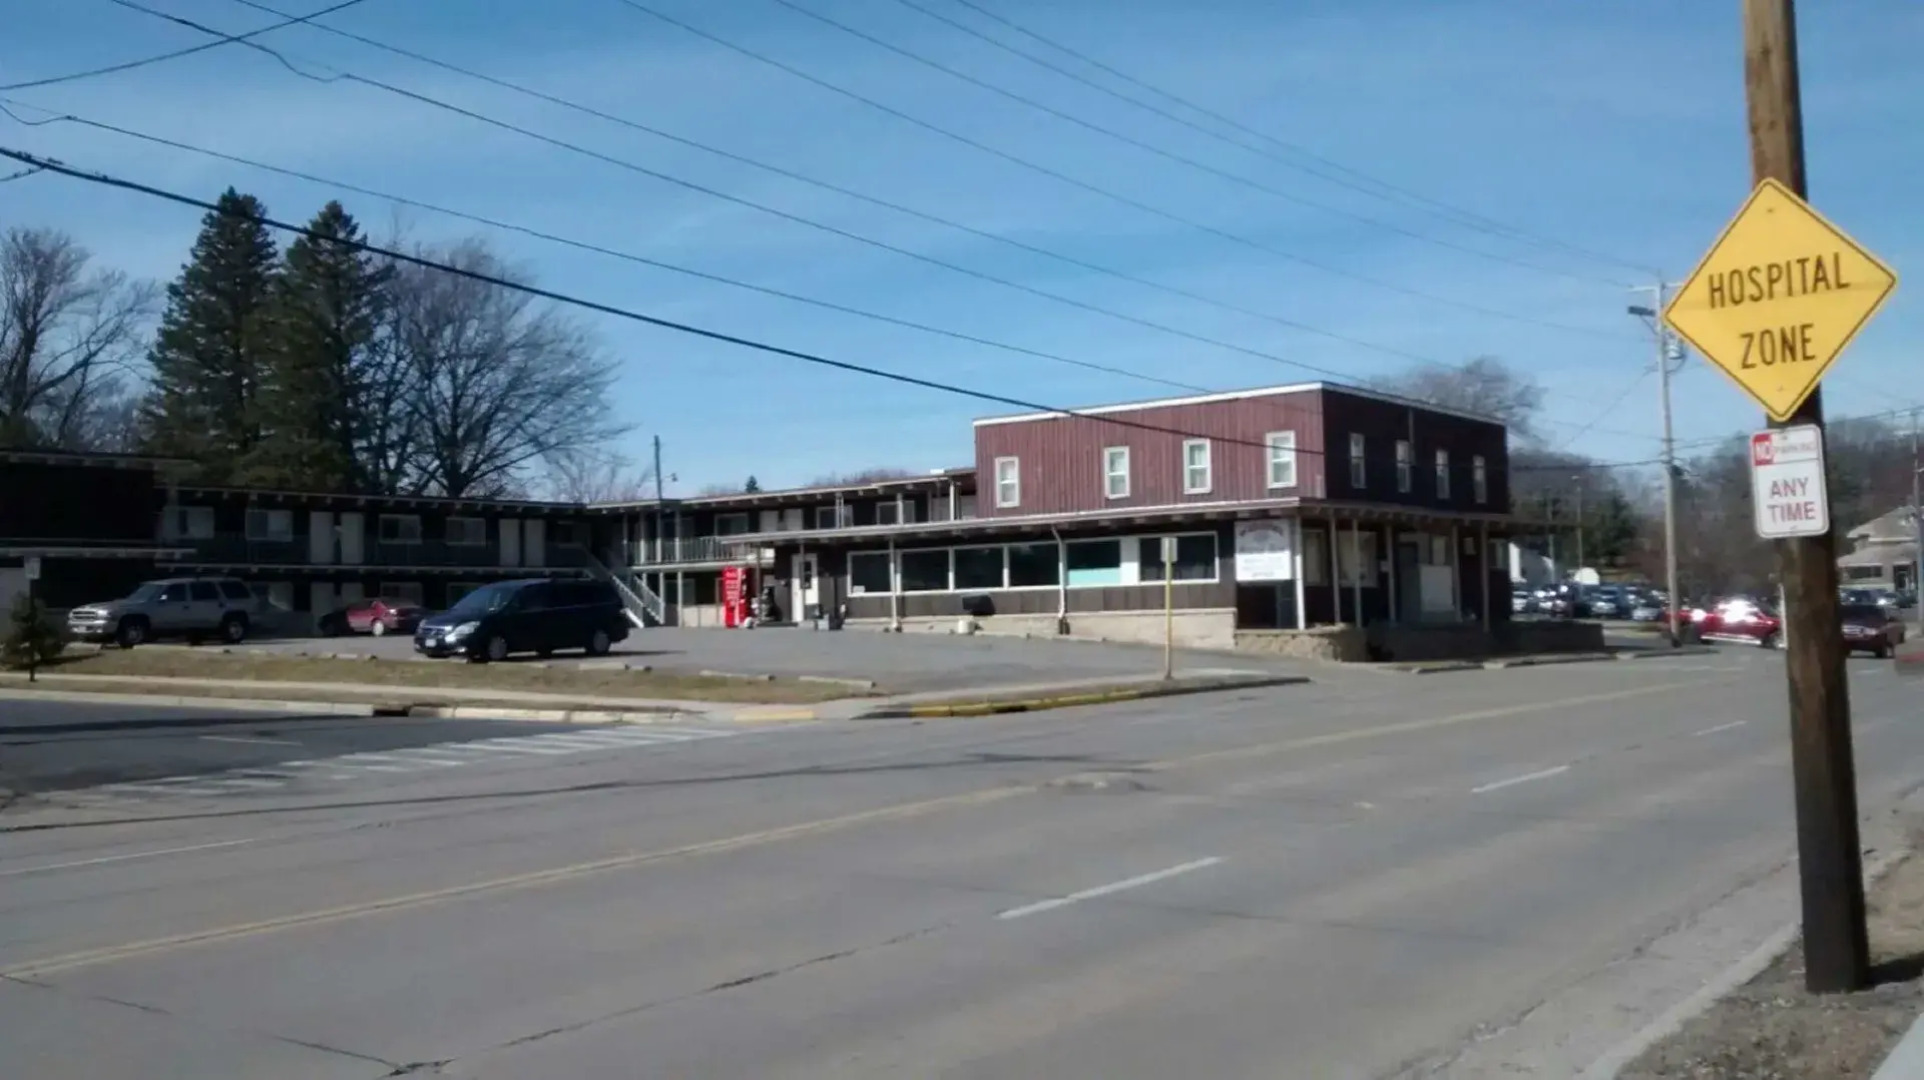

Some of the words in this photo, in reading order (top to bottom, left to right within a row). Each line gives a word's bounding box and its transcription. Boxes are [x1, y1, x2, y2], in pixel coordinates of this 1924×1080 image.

[1708, 252, 1850, 309] HOSPITAL
[1740, 323, 1816, 369] ZONE
[1770, 477, 1809, 498] ANY
[1766, 501, 1816, 523] TIME
